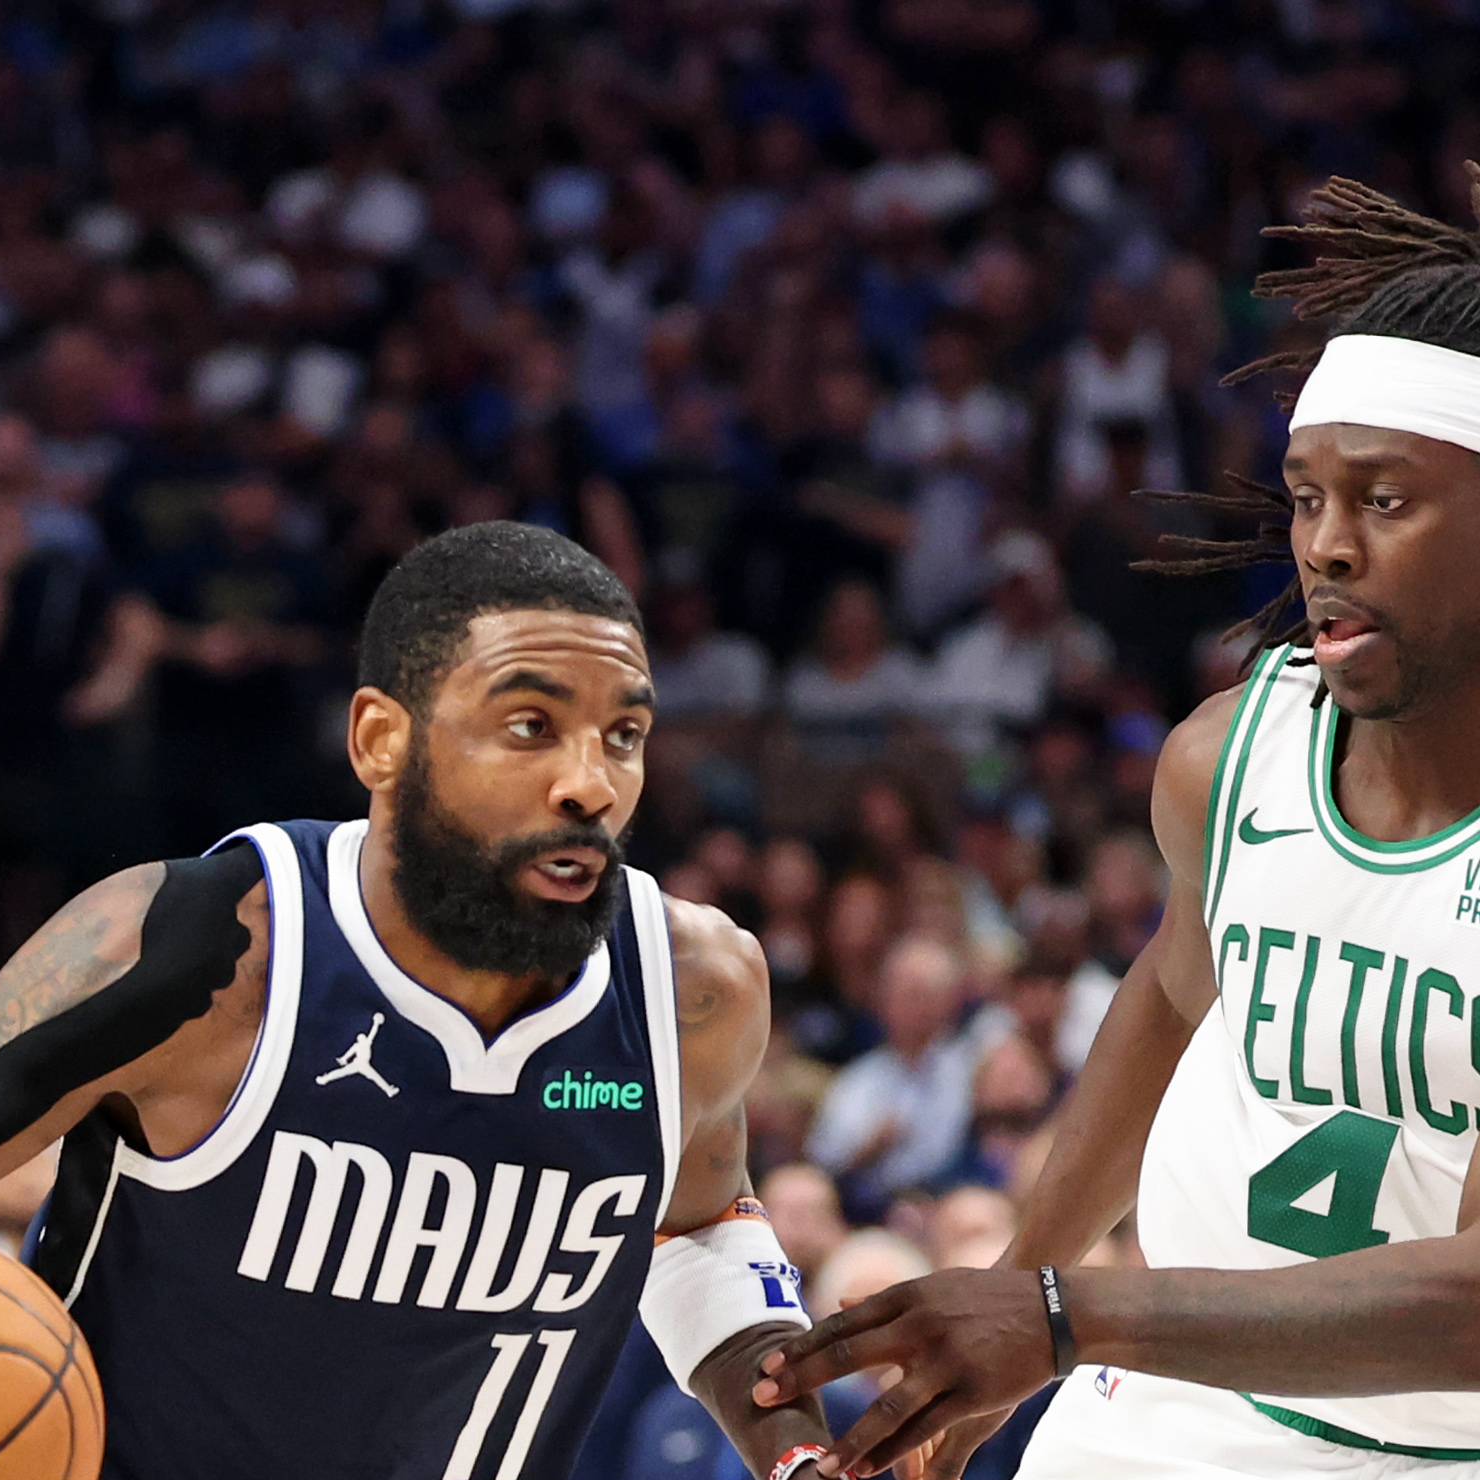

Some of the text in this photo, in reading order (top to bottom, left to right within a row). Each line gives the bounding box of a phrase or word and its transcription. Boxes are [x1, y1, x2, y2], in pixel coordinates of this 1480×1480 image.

[542, 1069, 645, 1111] chime
[236, 1130, 647, 1313] MAVS
[1247, 1109, 1402, 1260] 4
